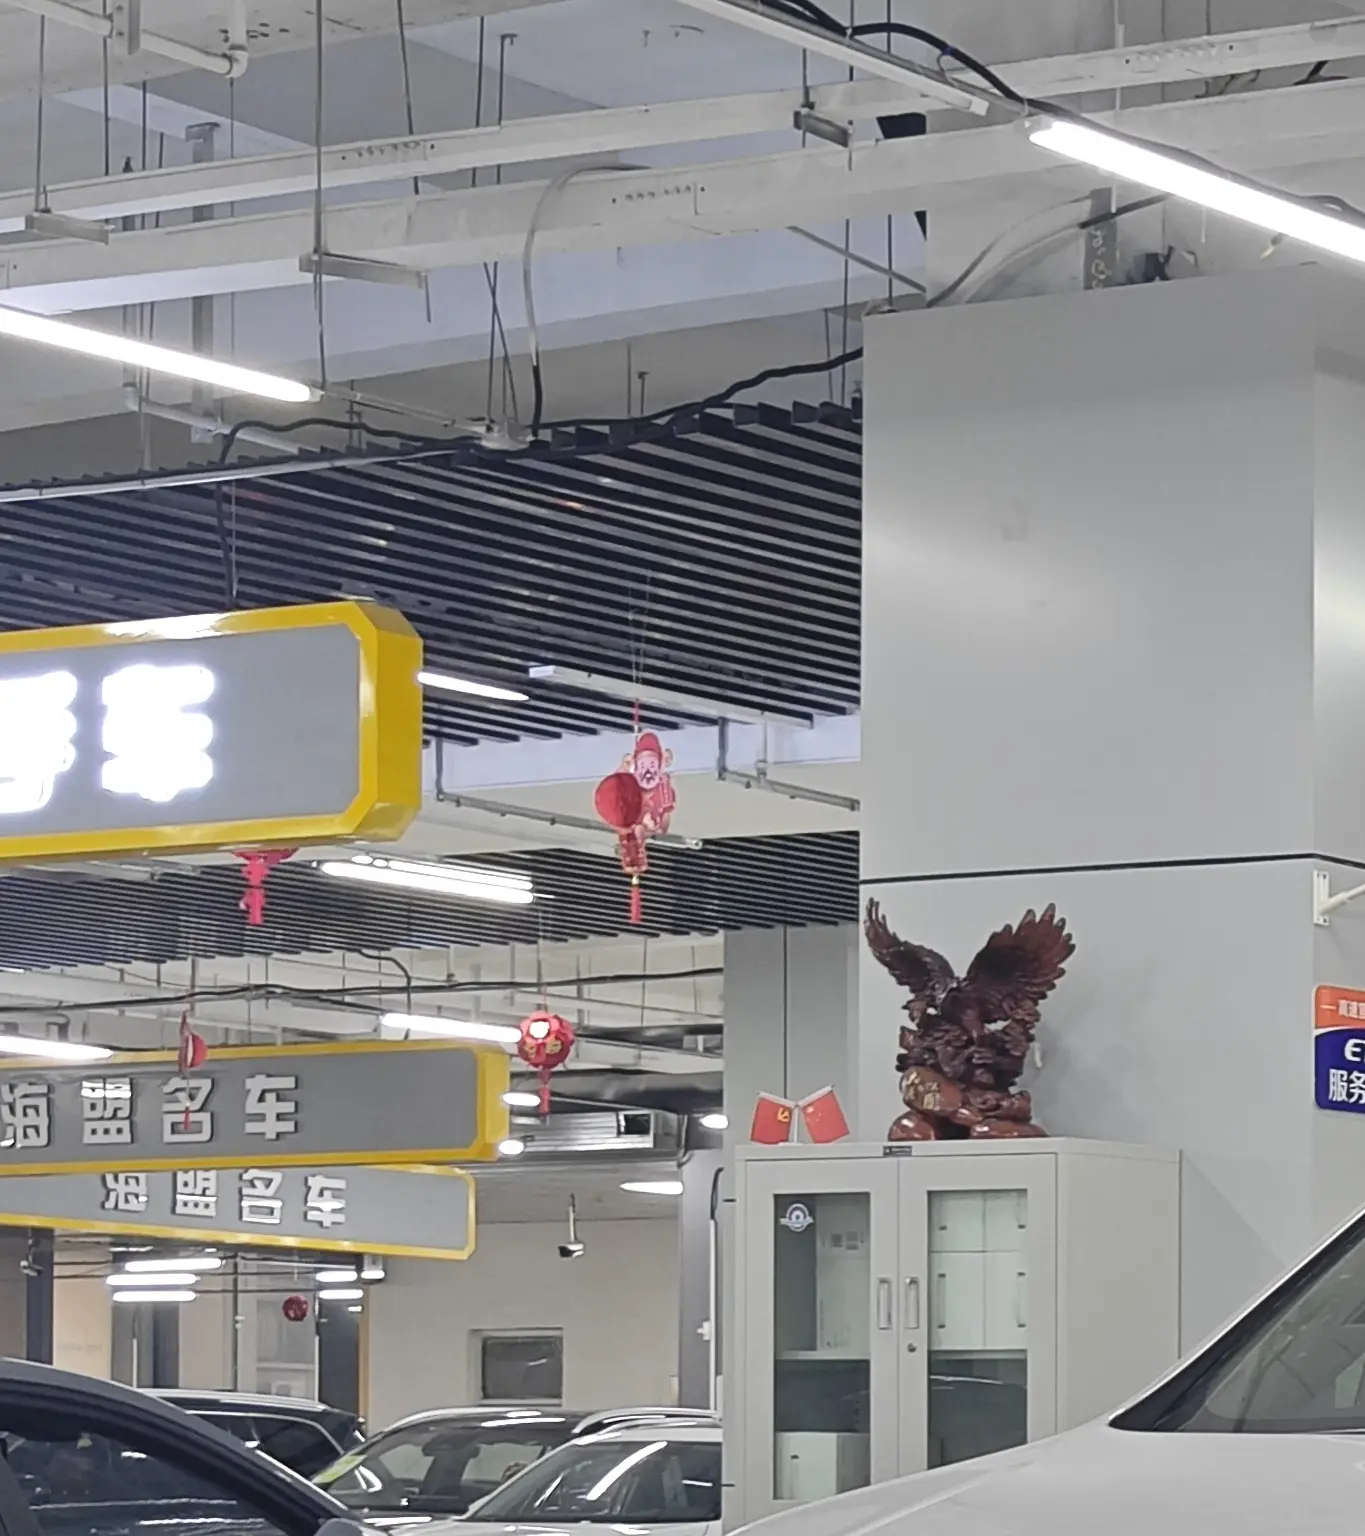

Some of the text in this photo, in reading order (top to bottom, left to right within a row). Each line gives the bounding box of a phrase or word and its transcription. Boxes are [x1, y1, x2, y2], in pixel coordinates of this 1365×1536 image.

[0, 1073, 298, 1148] 海盟名车
[102, 1169, 347, 1228] 海盟名车
